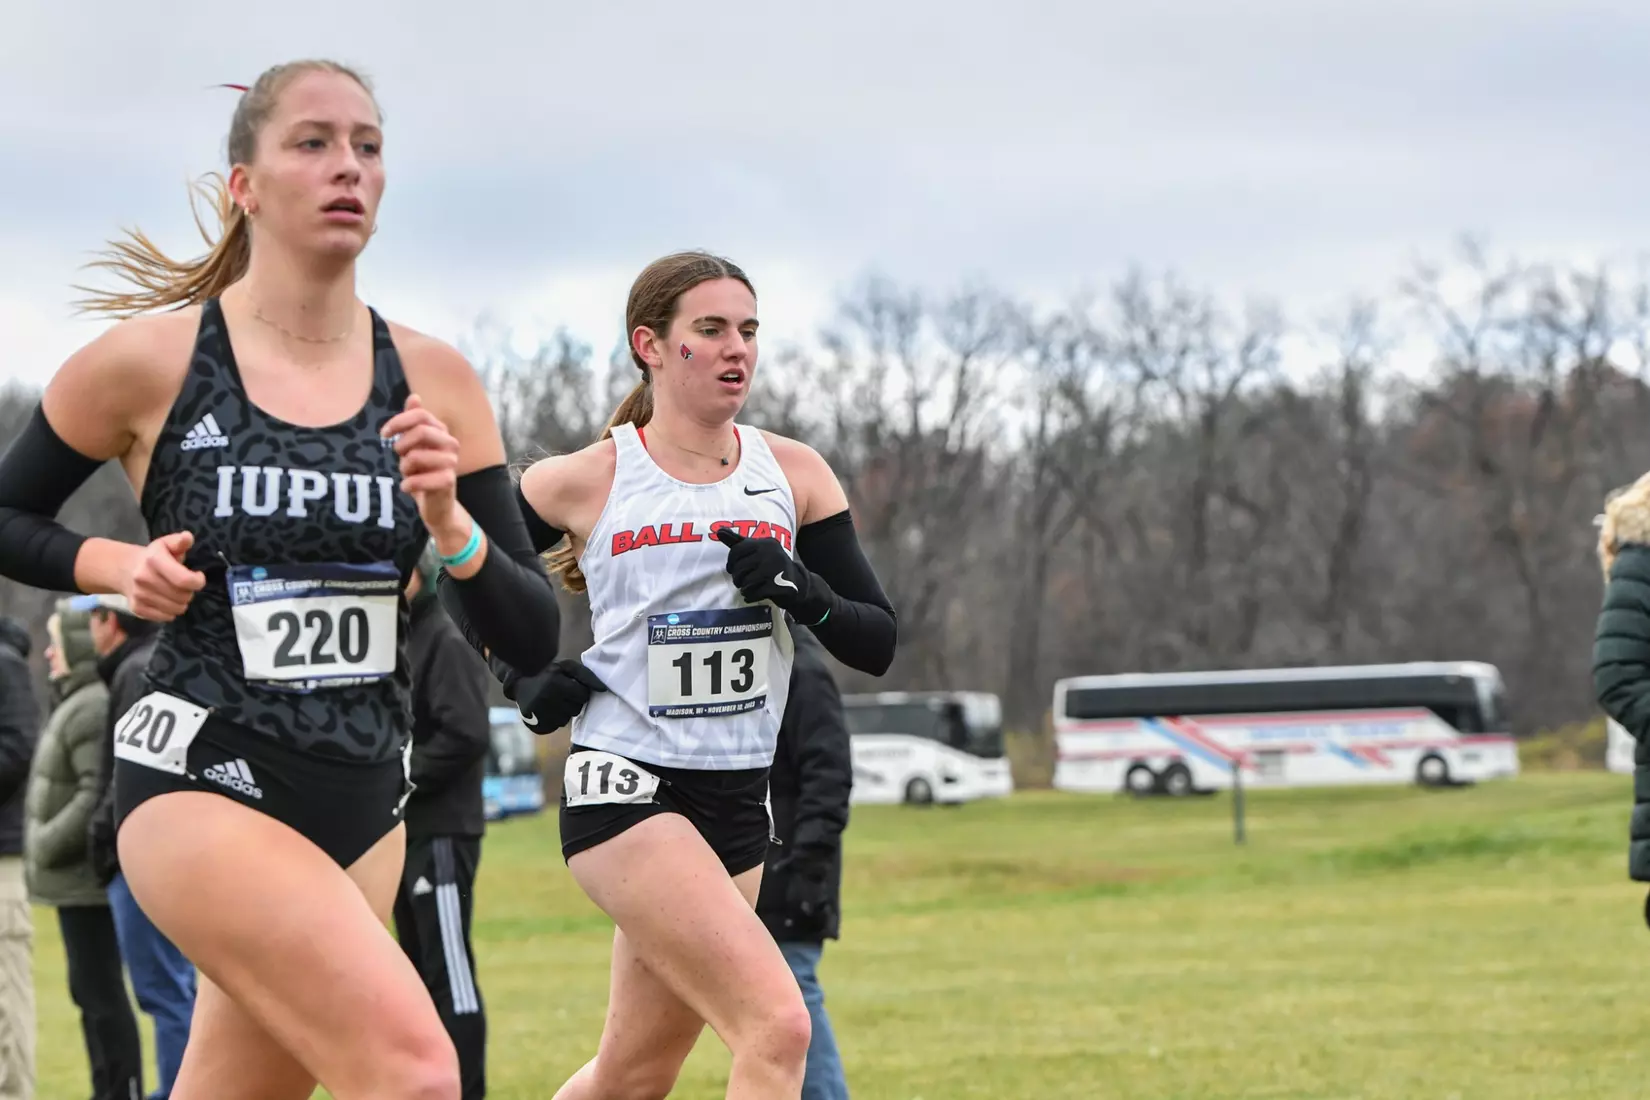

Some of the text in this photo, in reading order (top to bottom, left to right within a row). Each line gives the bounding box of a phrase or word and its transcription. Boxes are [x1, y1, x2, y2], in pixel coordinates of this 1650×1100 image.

[180, 435, 229, 451] adidas
[214, 465, 396, 529] IUPUI
[611, 522, 703, 557] BALL
[267, 607, 370, 668] 220
[667, 622, 772, 636] CROSS COUNTRY CHAMPIONSHIPS
[673, 648, 754, 696] 113
[708, 704, 736, 713] NOVEMBER
[116, 703, 176, 754] 220
[203, 768, 263, 800] adidas
[578, 761, 640, 796] 113
